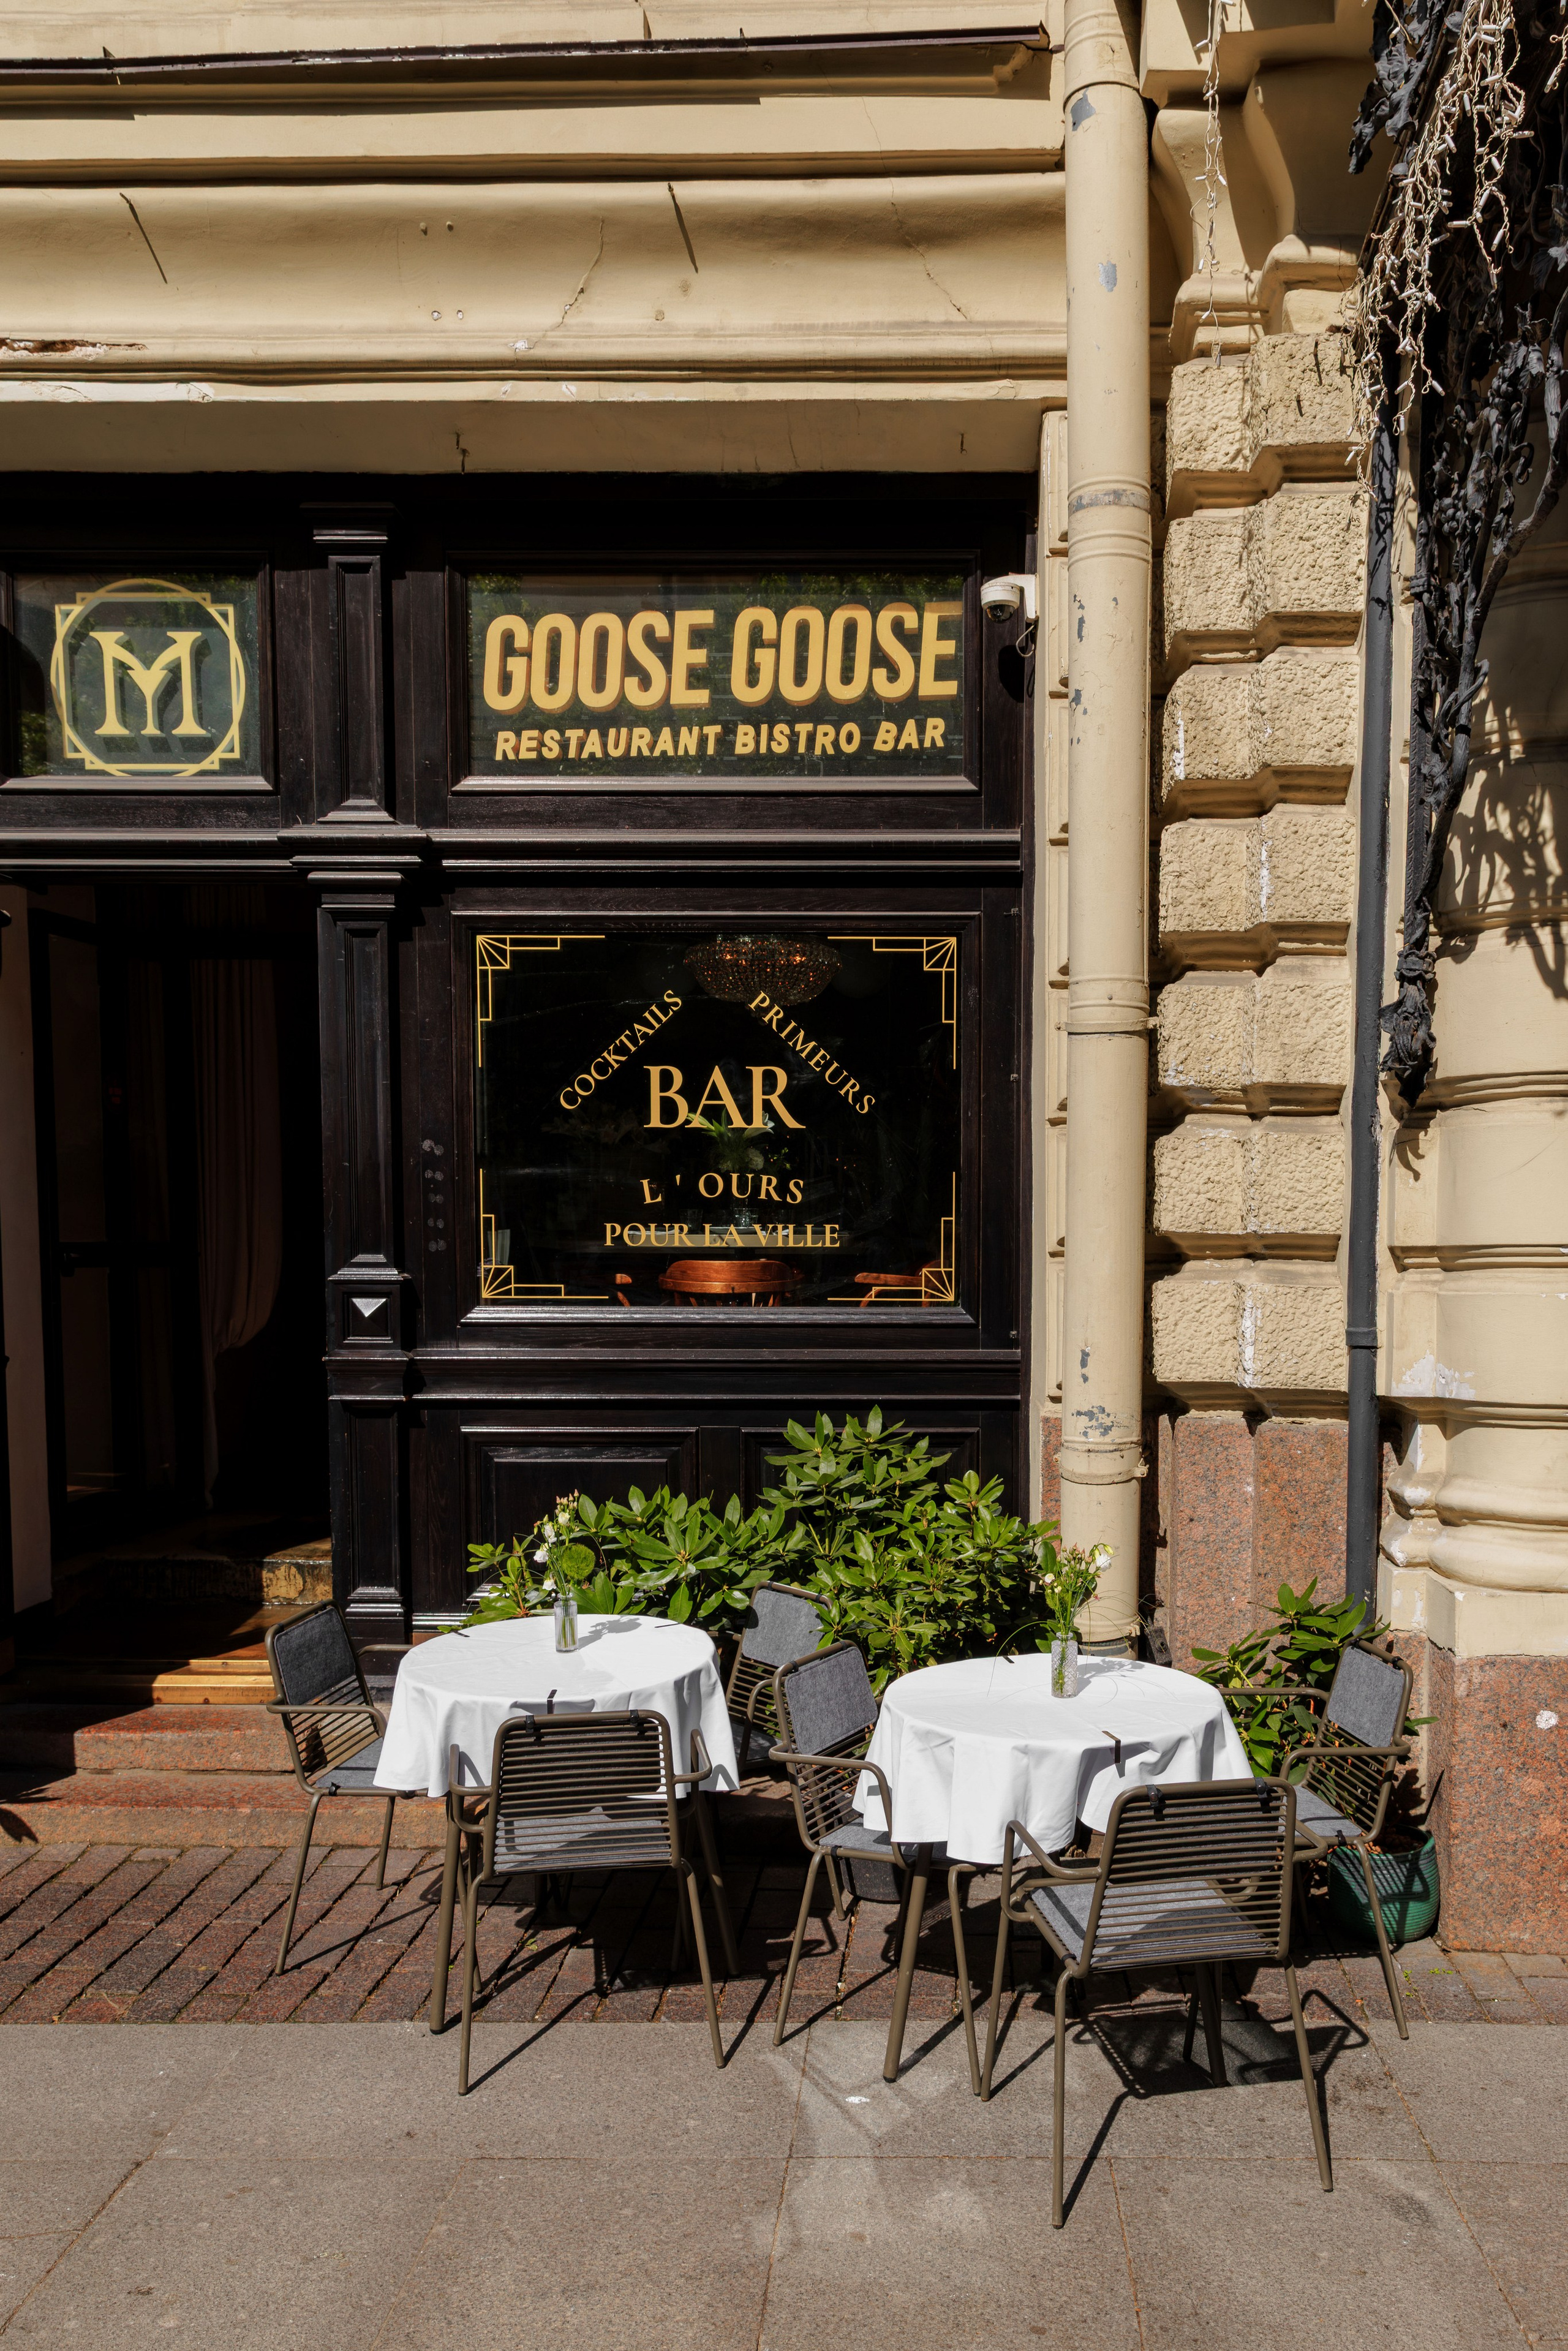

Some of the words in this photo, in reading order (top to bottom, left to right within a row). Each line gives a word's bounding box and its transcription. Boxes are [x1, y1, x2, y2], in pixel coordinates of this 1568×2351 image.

[483, 609, 716, 715] GOOSE
[730, 602, 963, 706] GOOSE
[495, 724, 723, 761] RESTAURANT
[734, 721, 861, 756] BISTRO
[873, 717, 945, 752] BAR
[560, 989, 682, 1110] COCKTAILS
[748, 990, 876, 1114] PRIMEURS
[643, 1065, 806, 1129] BAR
[604, 1222, 698, 1247] POUR
[702, 1223, 745, 1247] LA
[752, 1224, 840, 1247] VILLE
